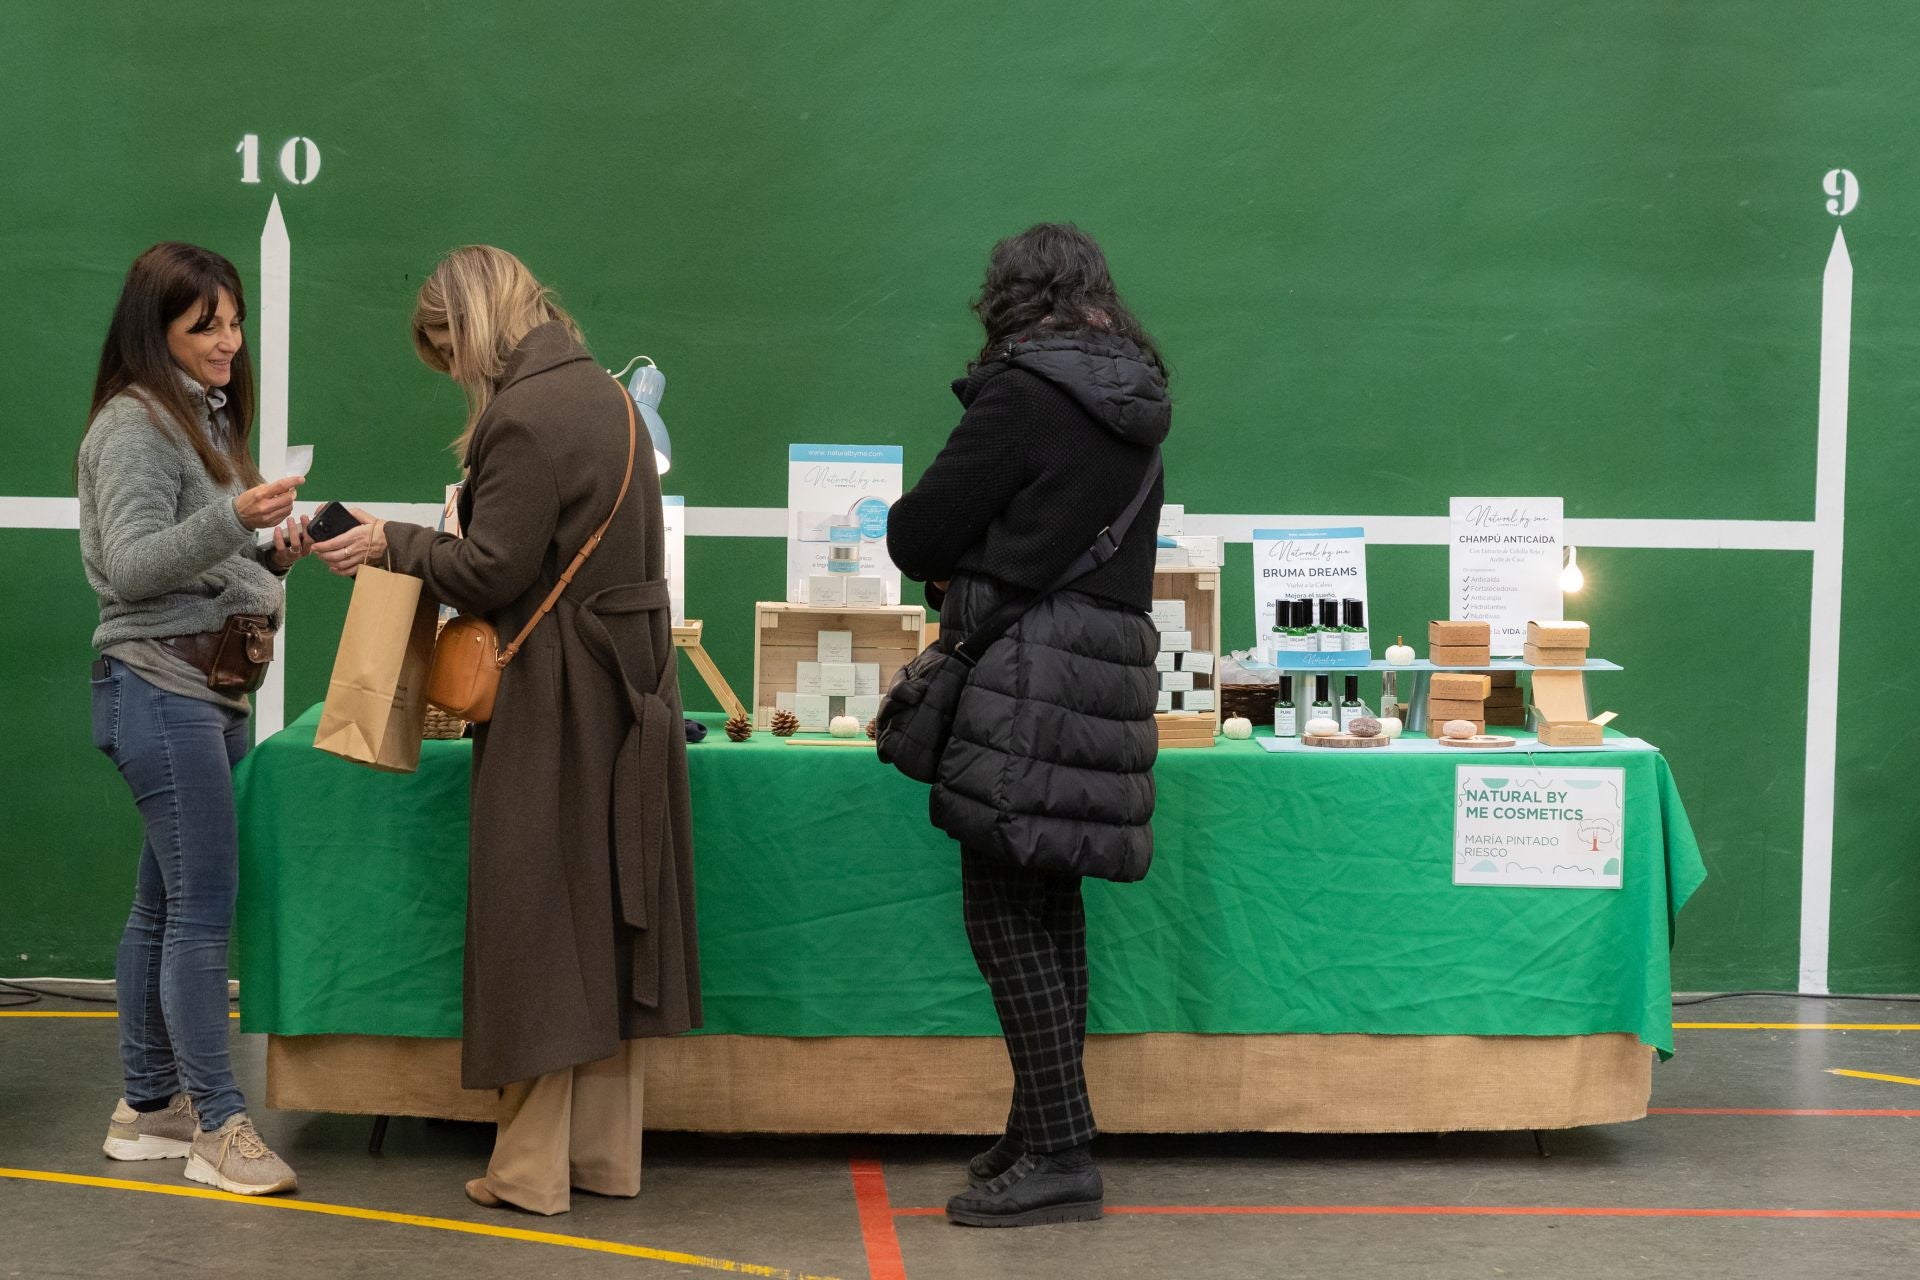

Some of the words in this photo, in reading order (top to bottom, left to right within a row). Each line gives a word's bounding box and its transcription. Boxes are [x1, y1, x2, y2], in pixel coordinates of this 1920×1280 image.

[236, 134, 321, 185] 10
[1822, 168, 1860, 217] 9
[1465, 504, 1518, 527] Natural
[1519, 509, 1530, 528] by
[1533, 515, 1549, 523] me
[1459, 533, 1501, 544] CHAMPÚ
[1504, 533, 1556, 544] ANTICAÍDA
[1268, 541, 1319, 562] Natural
[1320, 542, 1334, 562] by
[1263, 568, 1306, 578] BRUMA
[1309, 567, 1358, 577] DREAMS
[1466, 789, 1542, 804] NATURAL
[1546, 791, 1568, 804] BY
[1466, 806, 1488, 819] ME
[1493, 807, 1584, 821] COSMETICS
[1464, 833, 1503, 846] MARÍA
[1506, 835, 1560, 847] PINTADO
[1464, 847, 1508, 858] RIESCO
